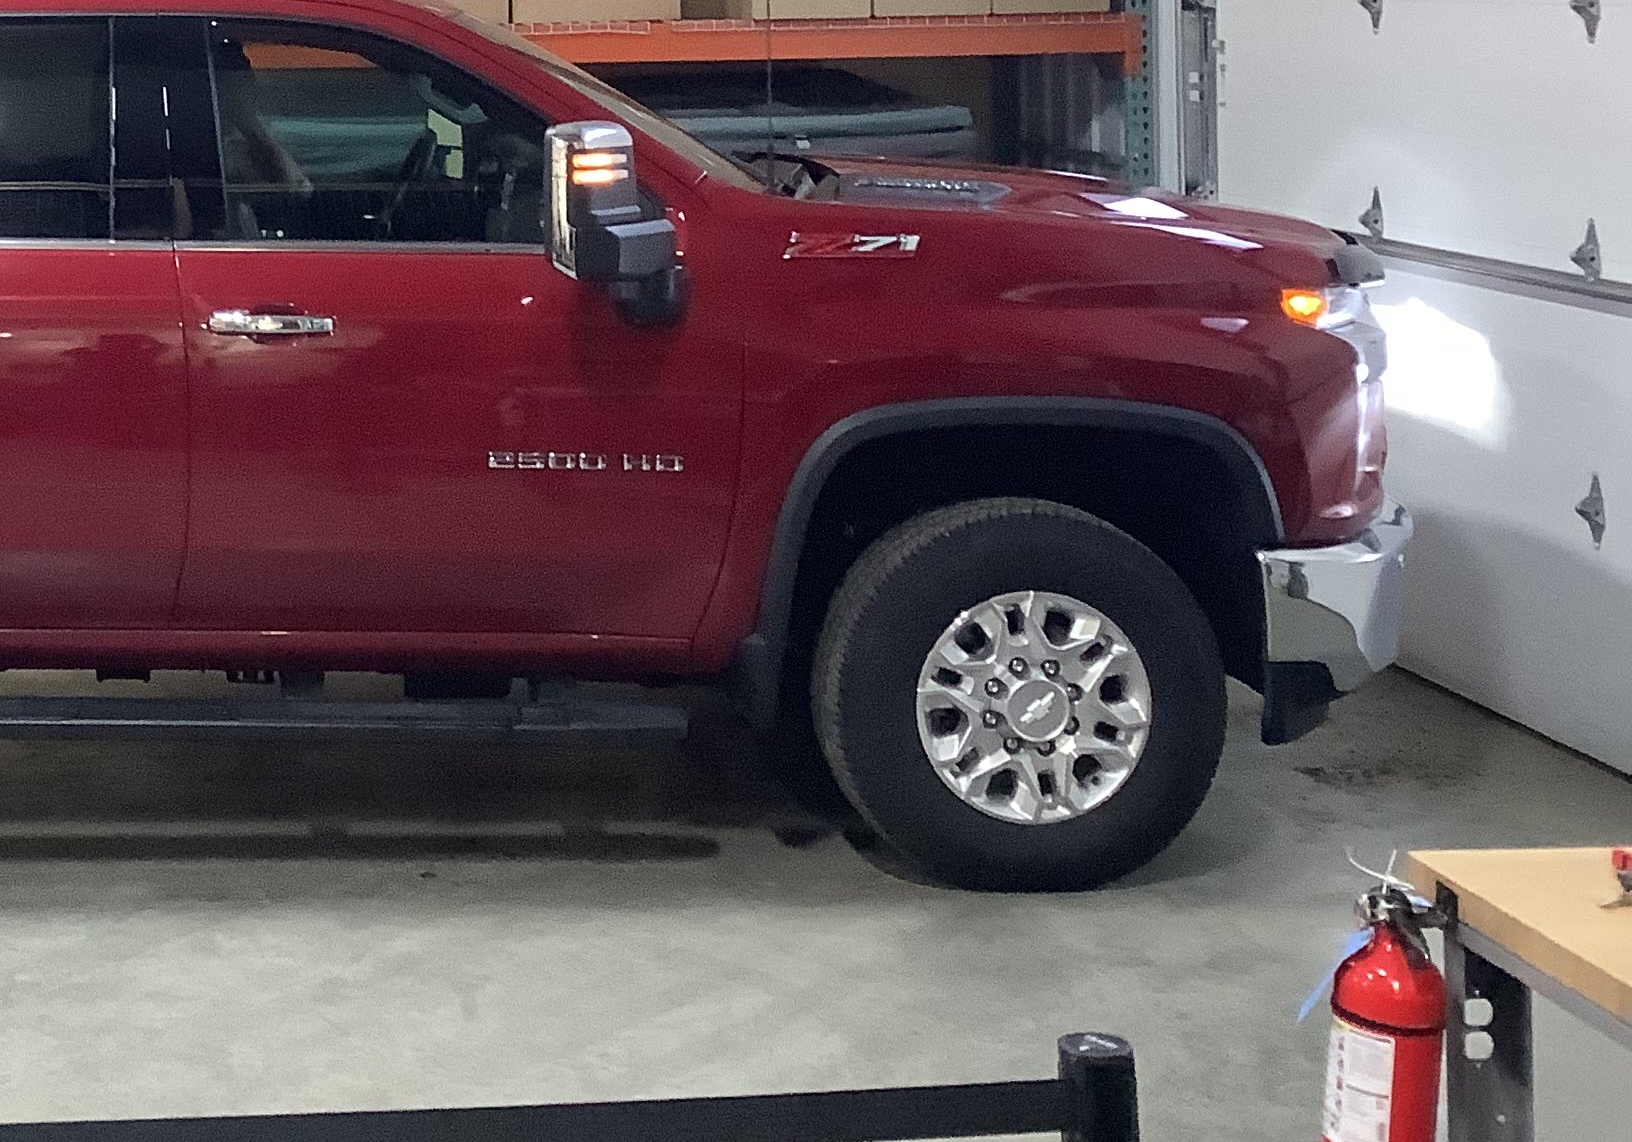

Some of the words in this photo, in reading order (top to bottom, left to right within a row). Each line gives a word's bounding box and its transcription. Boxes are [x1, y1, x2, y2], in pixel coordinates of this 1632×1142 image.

[783, 231, 921, 259] Z71
[488, 451, 607, 470] 2500
[623, 453, 684, 472] HD
